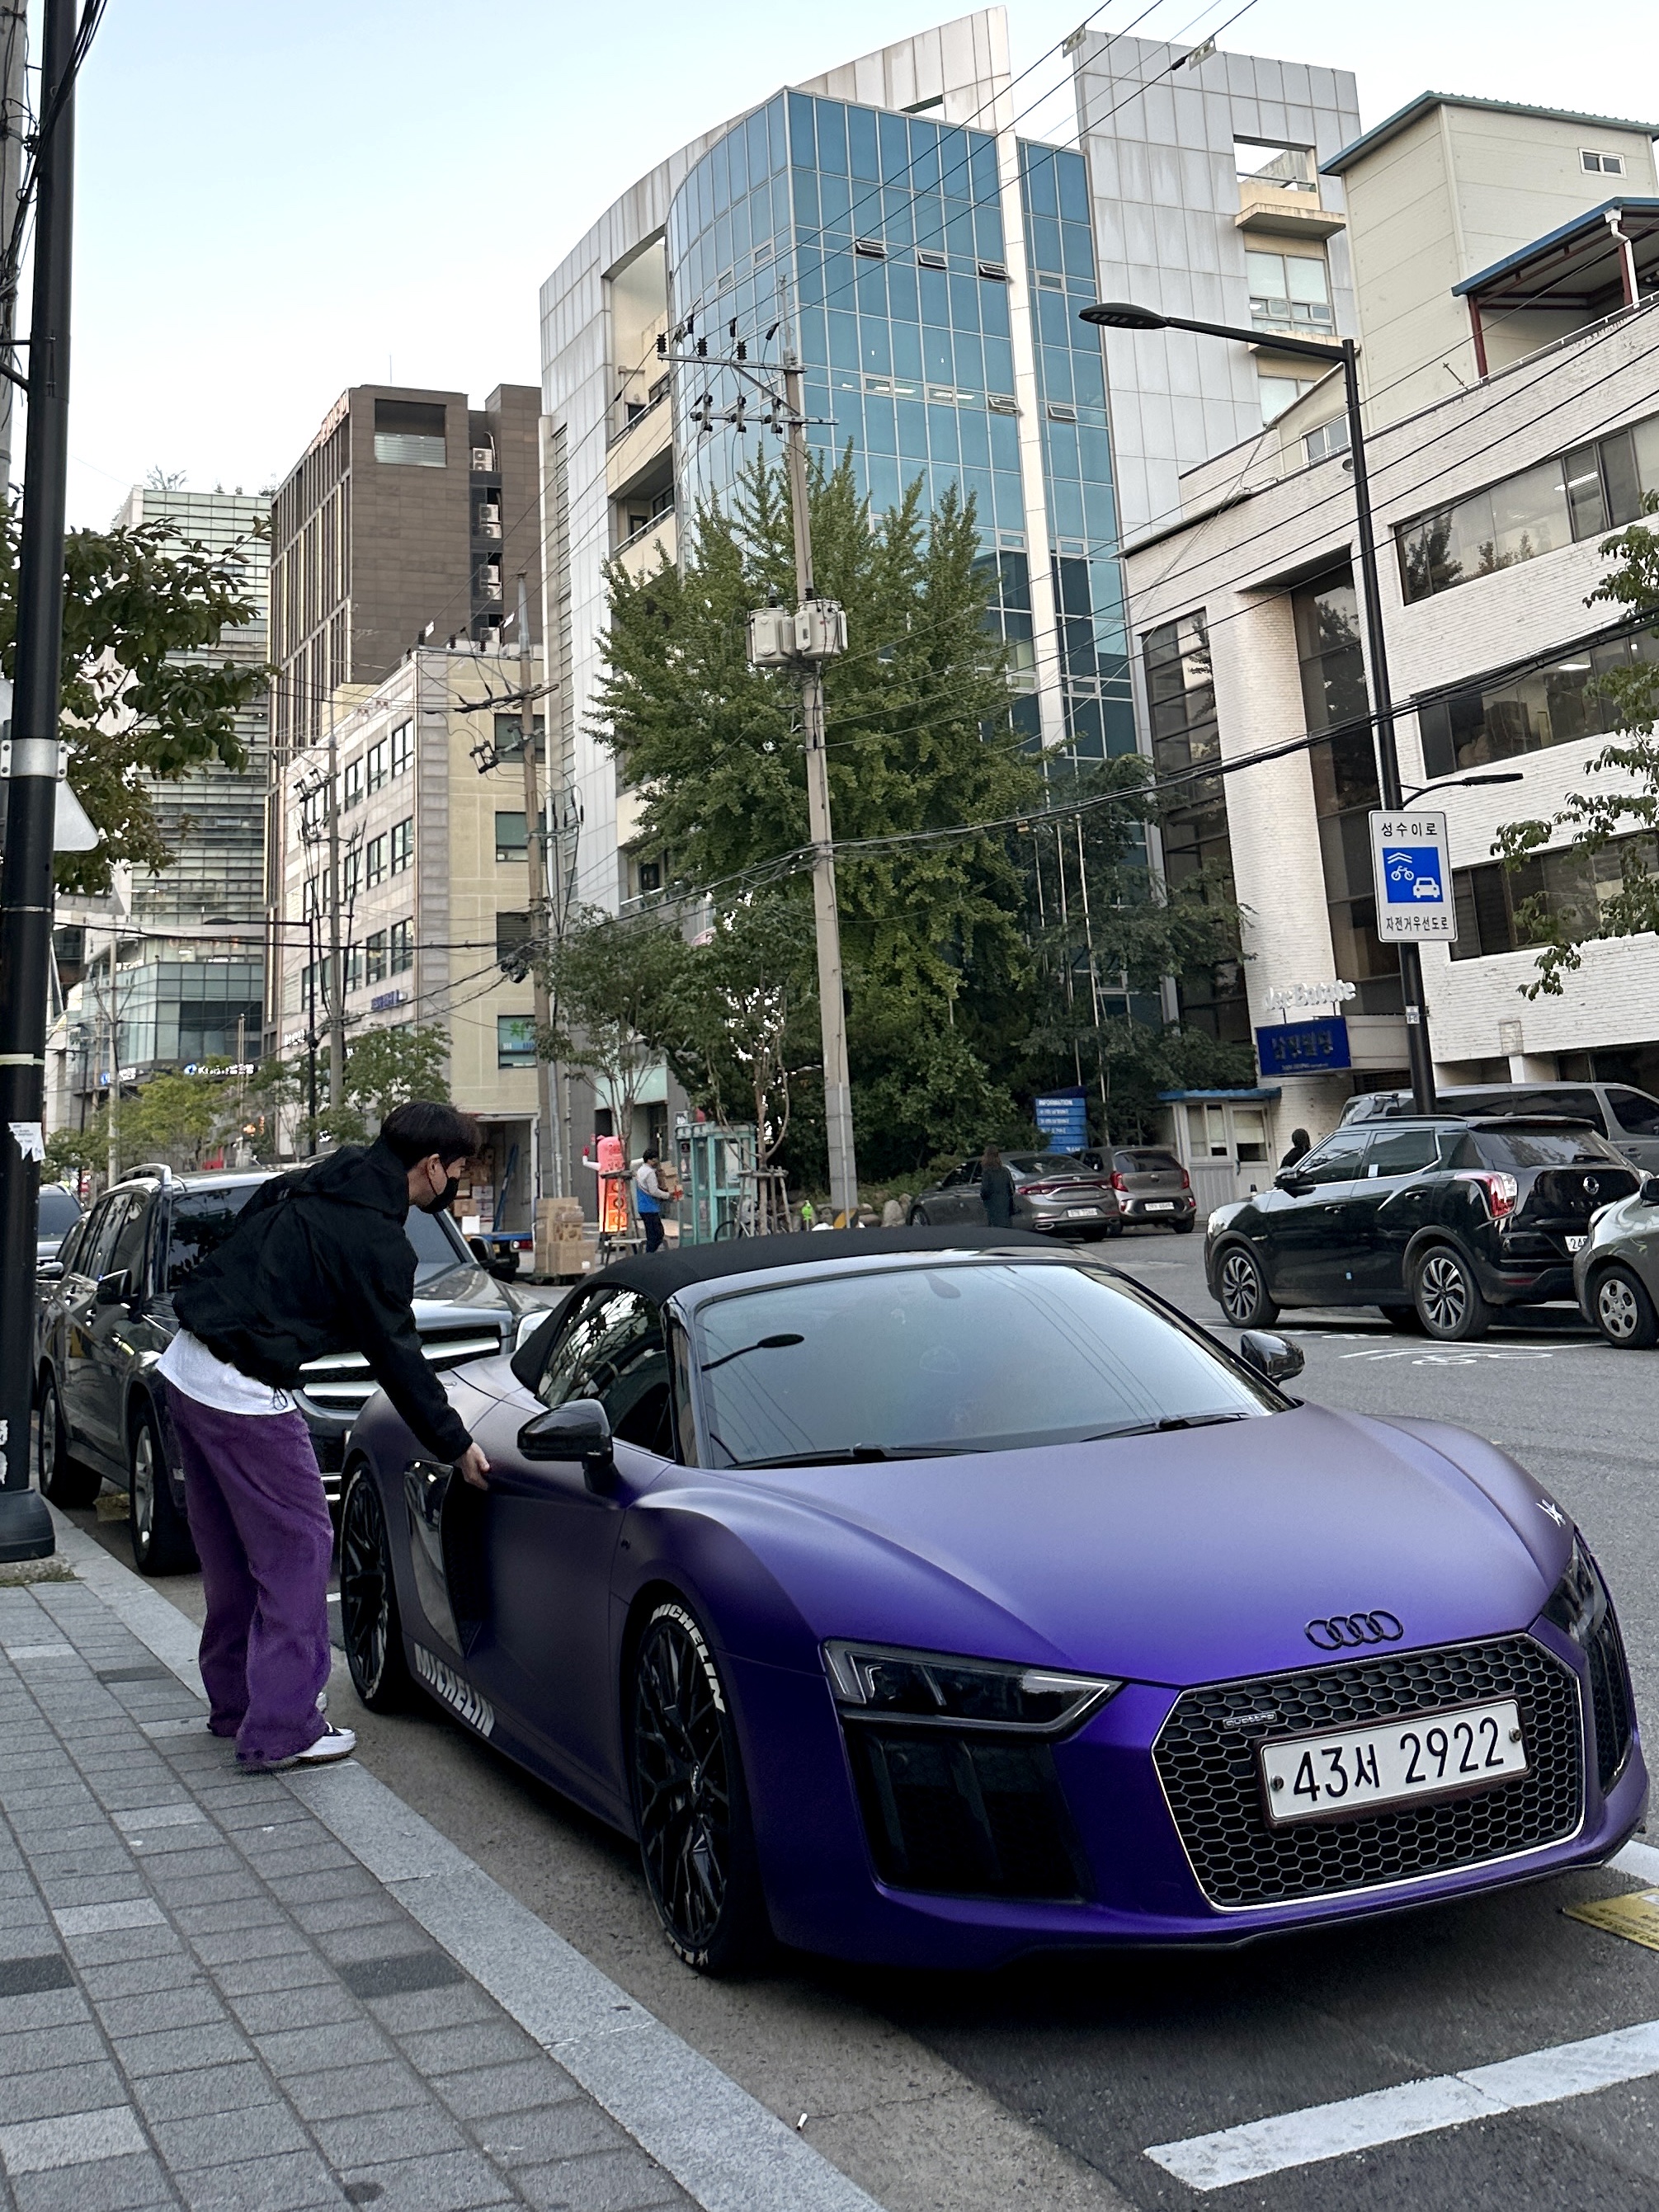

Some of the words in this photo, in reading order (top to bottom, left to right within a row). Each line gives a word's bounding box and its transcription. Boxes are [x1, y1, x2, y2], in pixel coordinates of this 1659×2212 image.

[1381, 822, 1437, 837] 성수이로
[1386, 915, 1449, 931] 자전거우선도로
[650, 1603, 726, 1713] MICHELIN
[414, 1642, 495, 1737] MICHELIN
[1226, 1714, 1275, 1727] quattro
[1293, 1743, 1380, 1801] 43서
[1400, 1716, 1504, 1784] 2922
